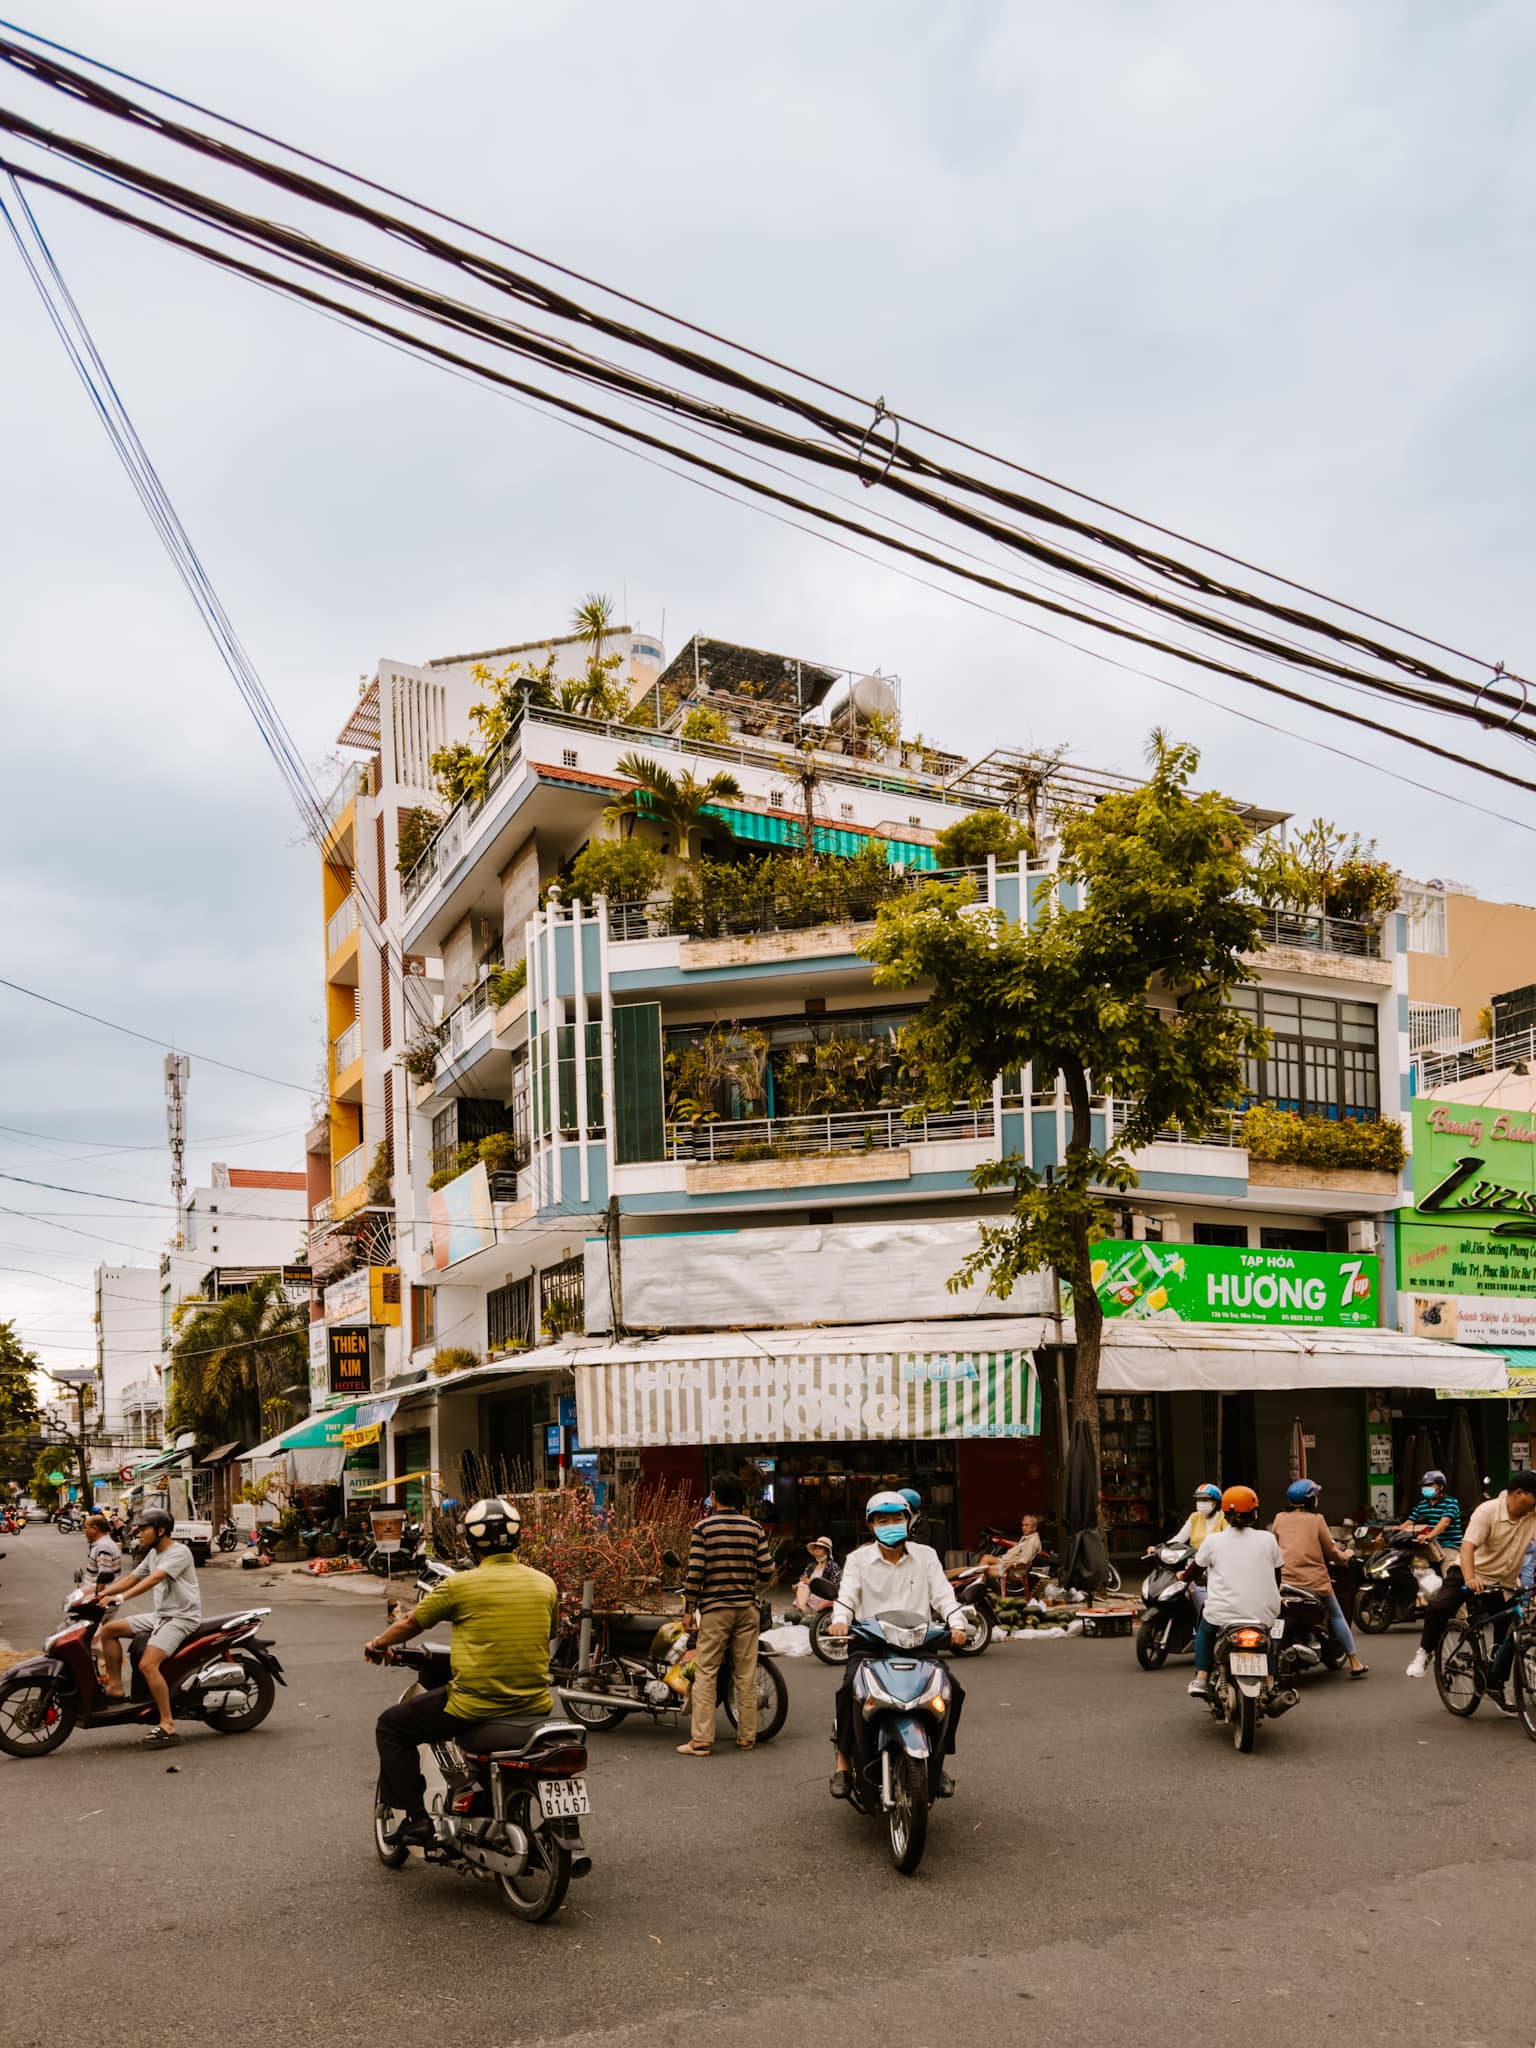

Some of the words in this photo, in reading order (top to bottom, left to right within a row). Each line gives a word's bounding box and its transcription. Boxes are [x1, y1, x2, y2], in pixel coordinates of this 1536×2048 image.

[1240, 1254, 1264, 1268] TẠP
[1267, 1255, 1295, 1268] HÓA
[1207, 1272, 1327, 1310] HƯƠNG
[332, 1330, 367, 1354] THIÊN
[340, 1359, 362, 1377] KIM
[335, 1381, 367, 1390] HOTEL
[546, 1797, 587, 1815] 814.67
